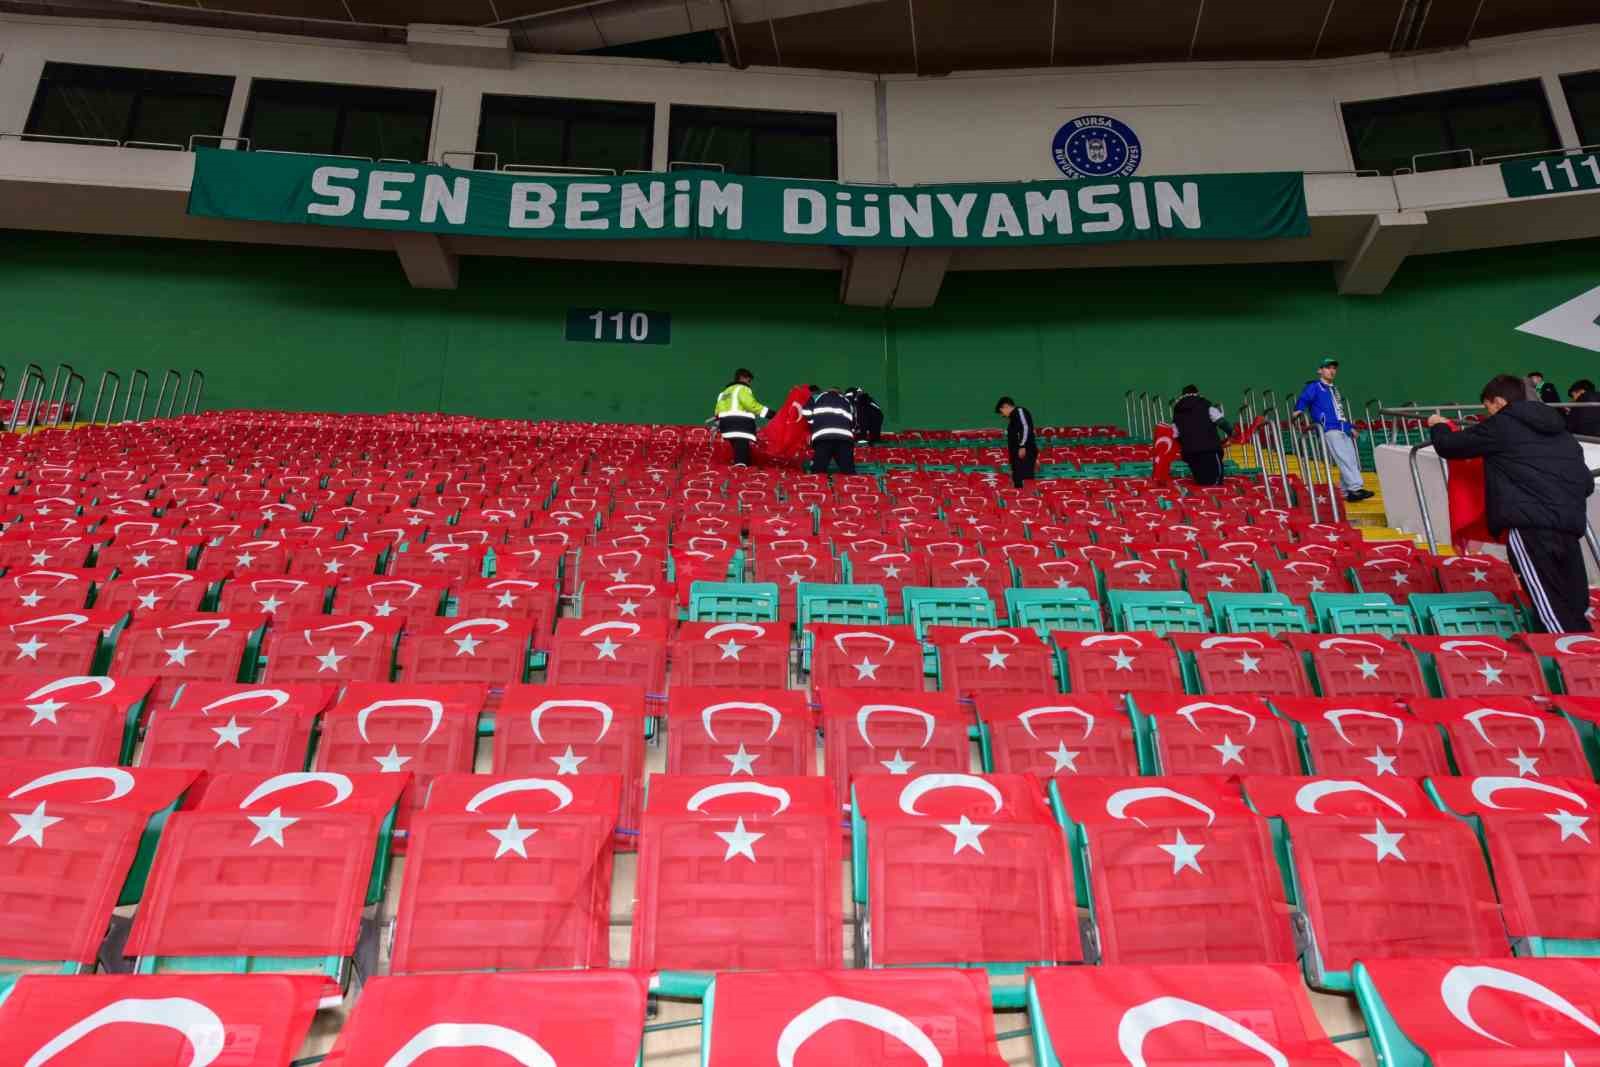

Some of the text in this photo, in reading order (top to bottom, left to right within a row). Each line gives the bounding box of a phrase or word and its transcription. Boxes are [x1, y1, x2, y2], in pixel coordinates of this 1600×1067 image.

[1073, 117, 1112, 128] BURSA
[1531, 155, 1600, 190] 111
[307, 166, 470, 224] SEN
[783, 181, 1201, 238] DÜNYAMSIN
[589, 310, 649, 341] 110
